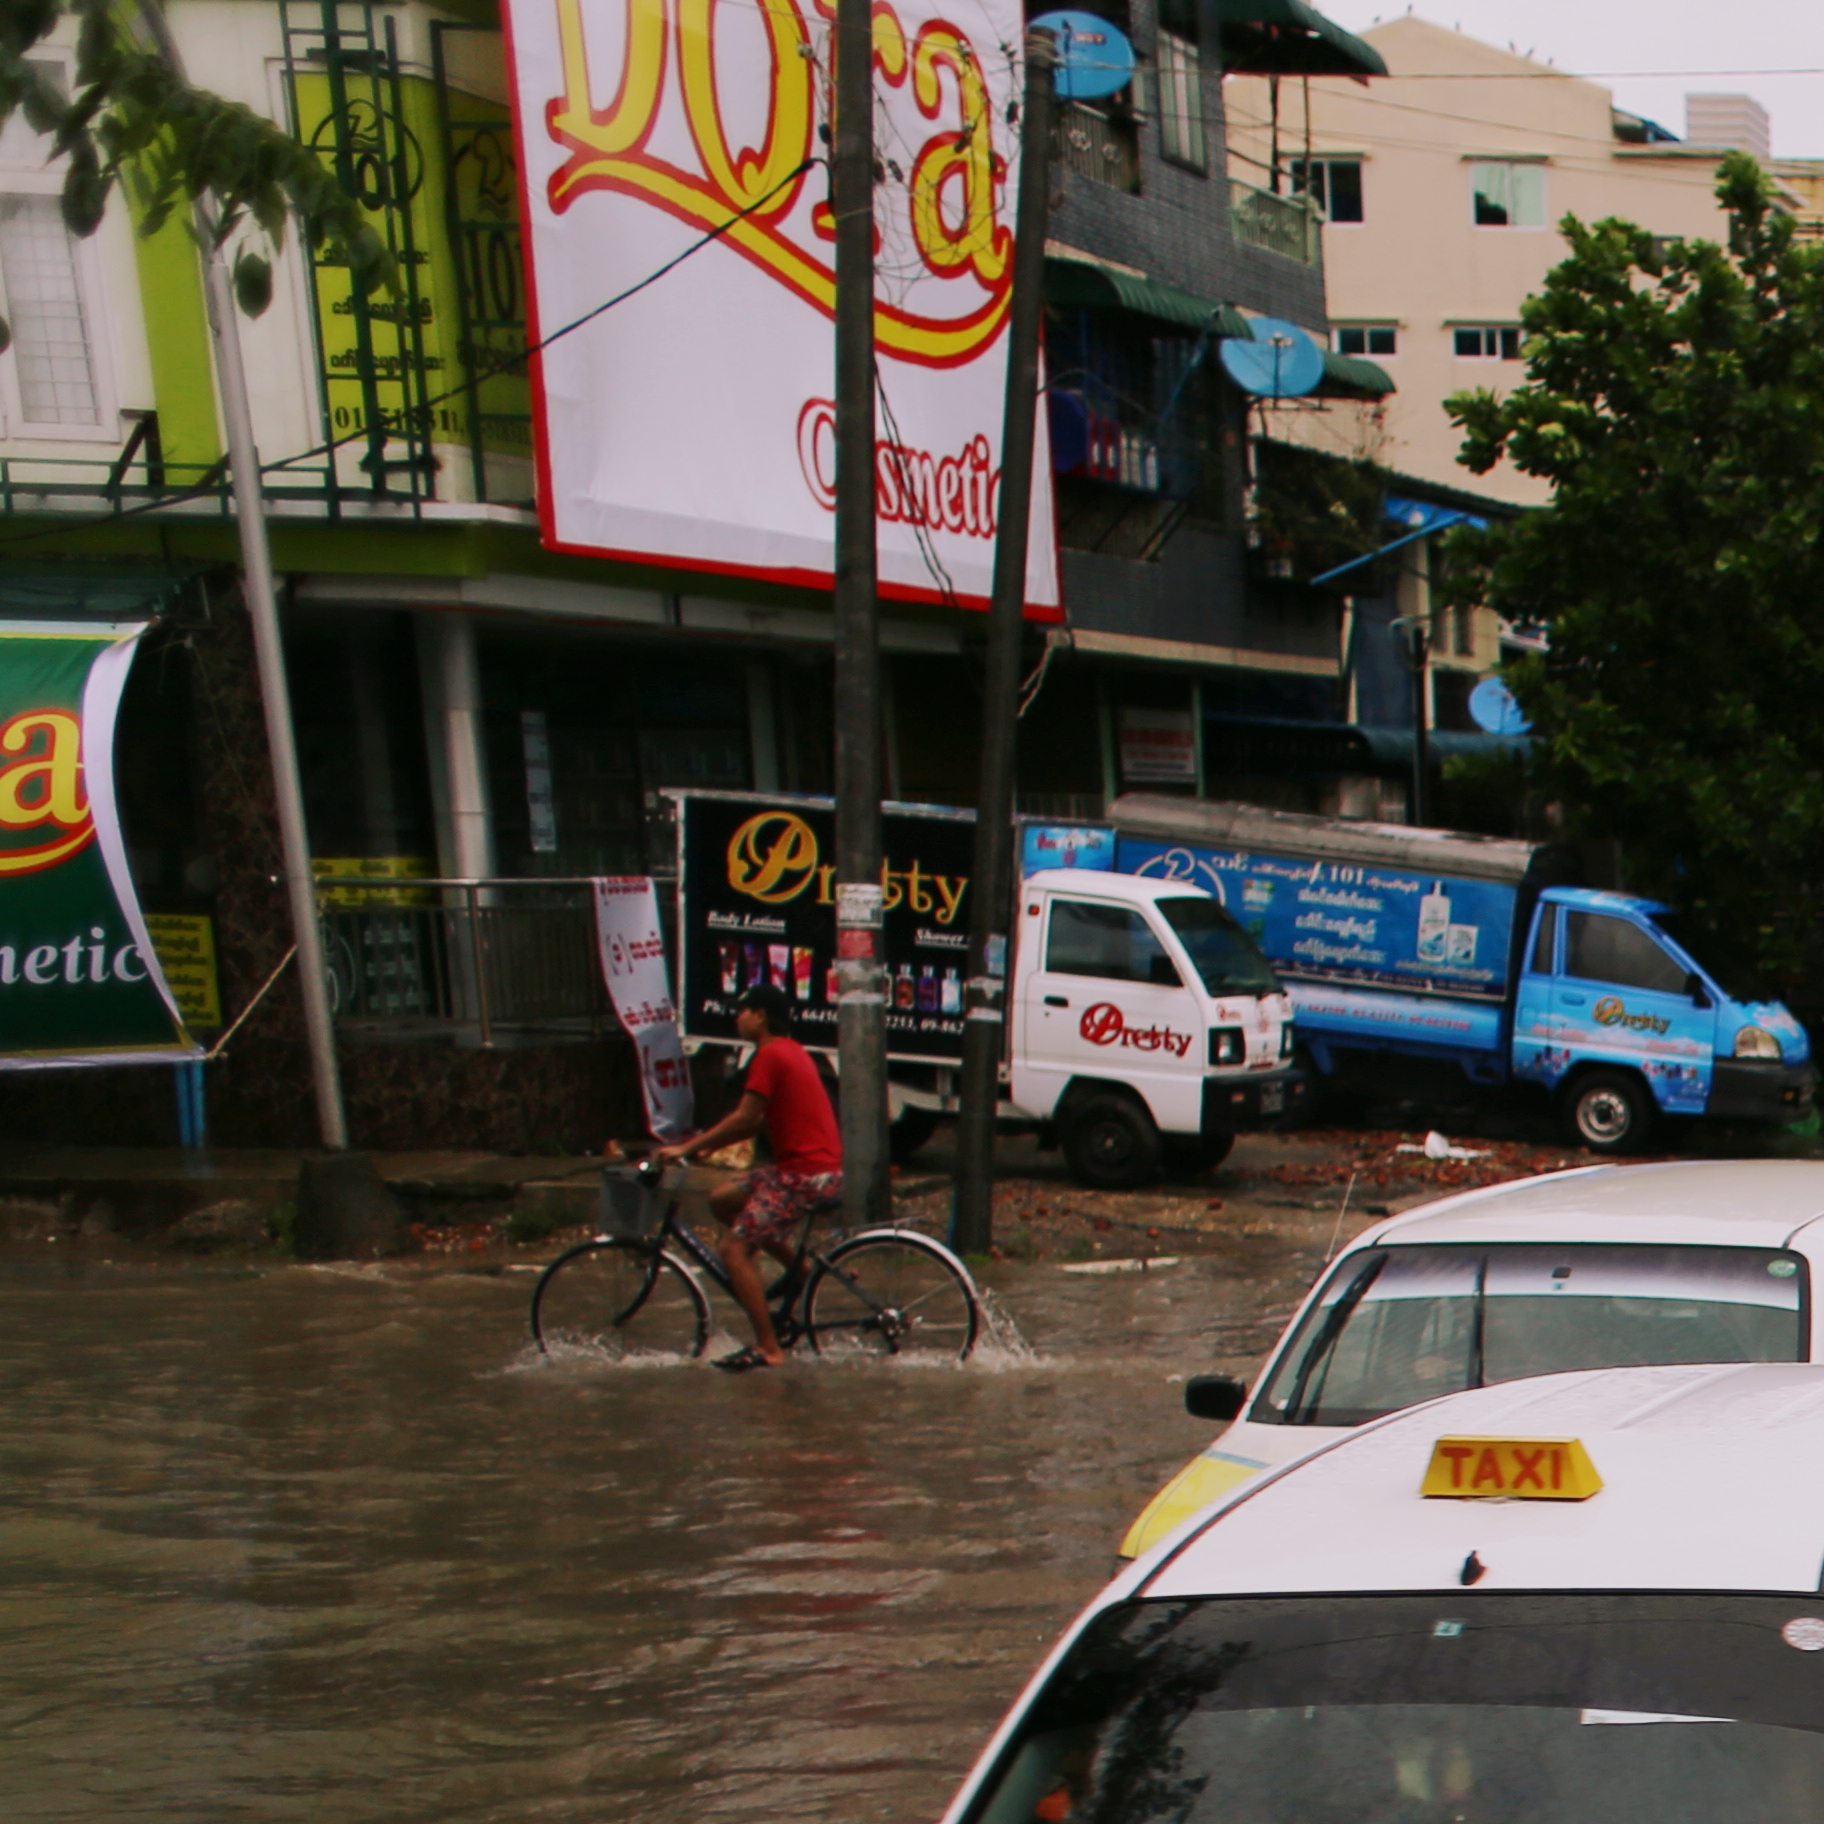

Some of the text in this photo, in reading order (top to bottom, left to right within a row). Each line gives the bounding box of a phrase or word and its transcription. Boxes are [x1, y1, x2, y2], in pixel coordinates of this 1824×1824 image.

[727, 811, 969, 924] Prtty
[1080, 1002, 1194, 1058] Pretty
[1440, 1446, 1563, 1490] TAXI
